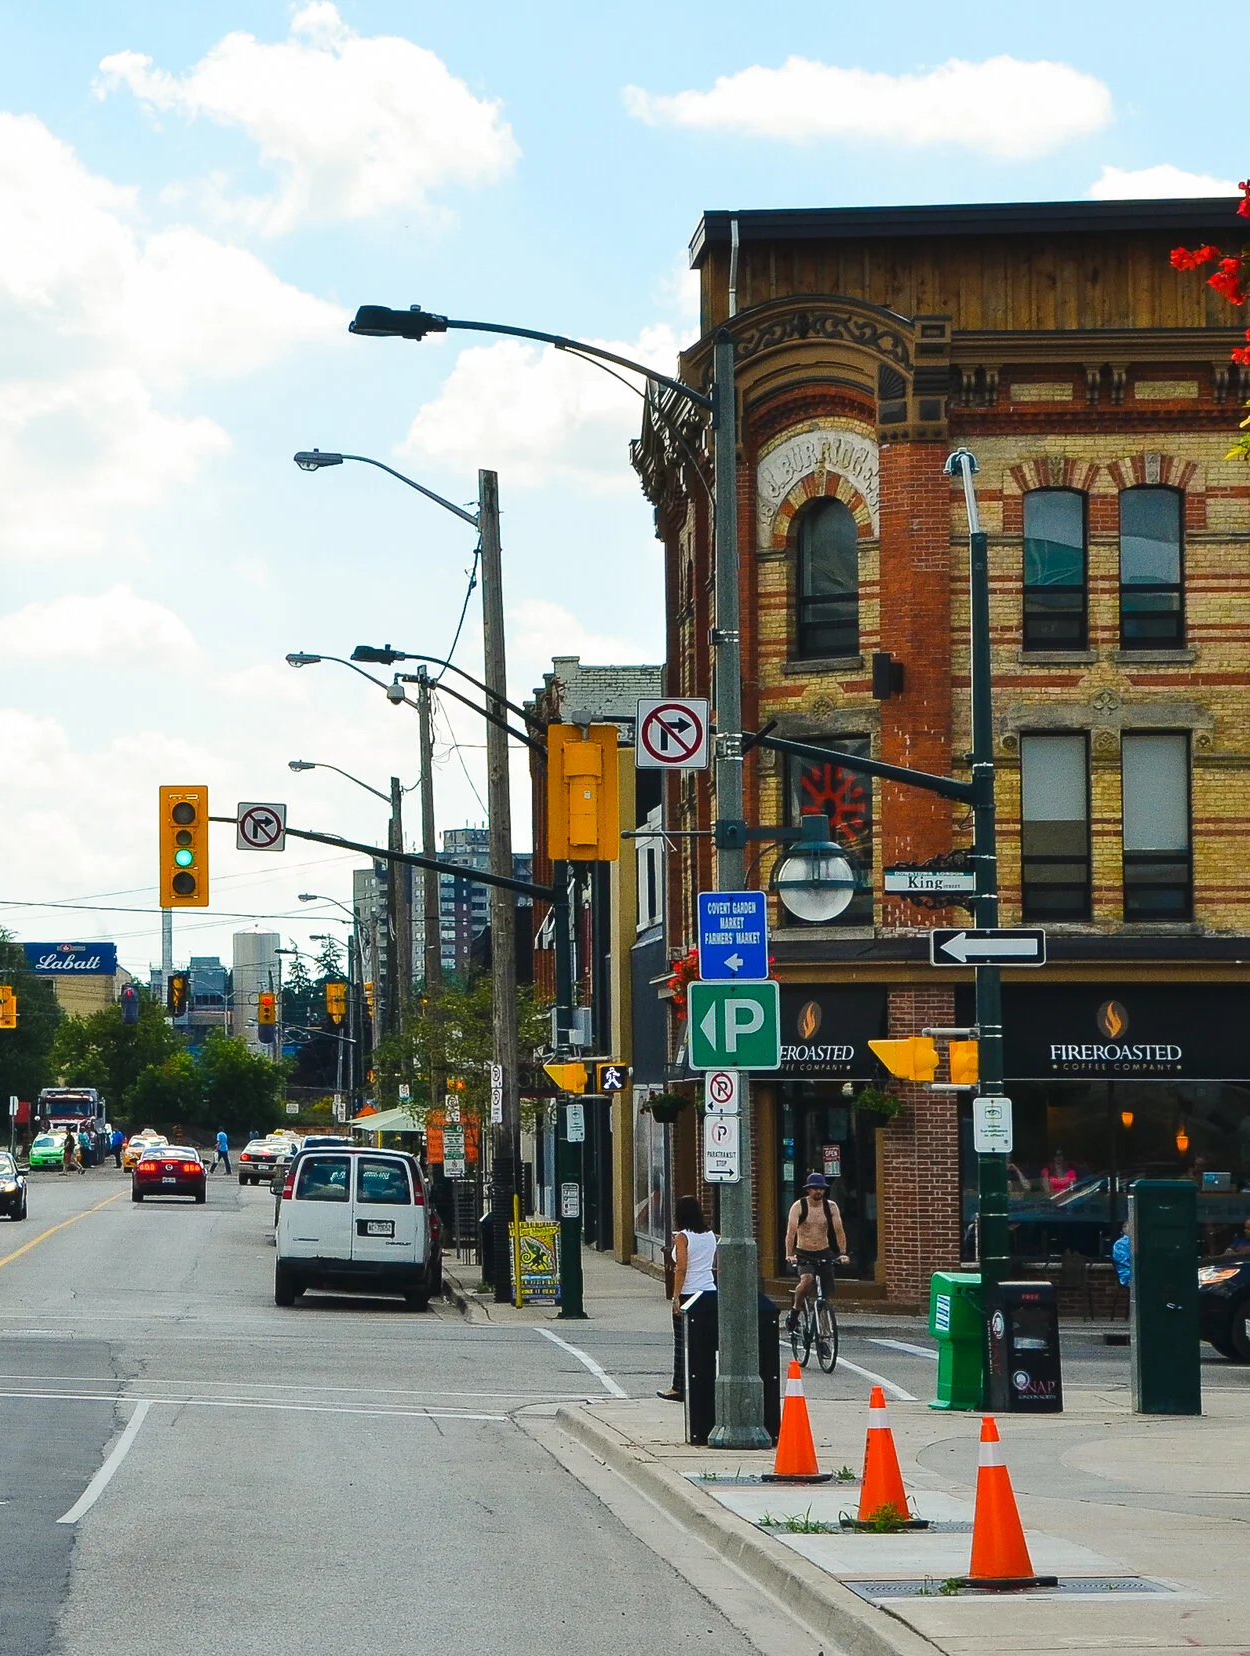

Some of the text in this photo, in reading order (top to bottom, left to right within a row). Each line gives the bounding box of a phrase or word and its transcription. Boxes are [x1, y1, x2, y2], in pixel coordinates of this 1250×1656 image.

[908, 875, 944, 890] King
[707, 901, 756, 915] COVENT GARDEN
[719, 916, 745, 929] MARKET
[736, 931, 760, 945] MARKET
[35, 953, 101, 970] Labatt
[724, 998, 765, 1053] P
[781, 1044, 855, 1061] EROASTED
[1050, 1044, 1182, 1060] FIREROASTED
[799, 1063, 843, 1071] COMPANY
[1062, 1063, 1172, 1071] COFFEE COMPANY
[706, 1150, 737, 1159] PARATRANSIT
[715, 1159, 728, 1167] STOP
